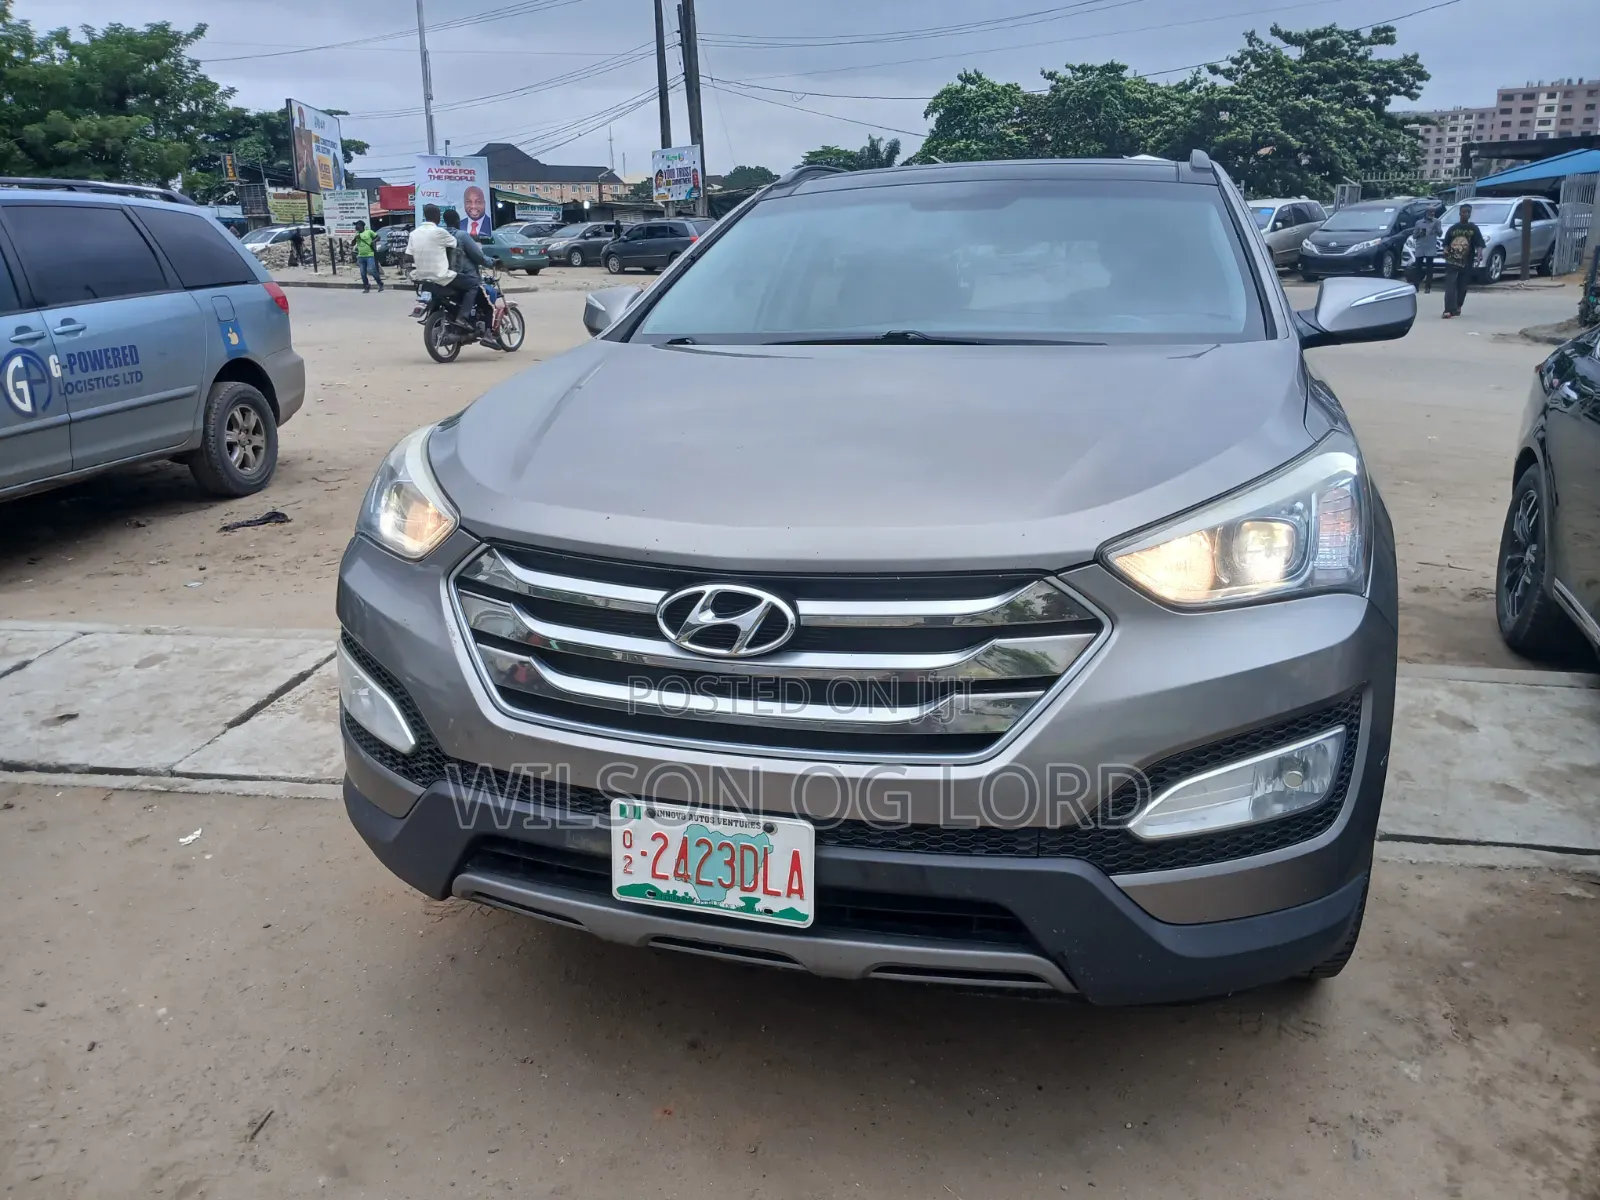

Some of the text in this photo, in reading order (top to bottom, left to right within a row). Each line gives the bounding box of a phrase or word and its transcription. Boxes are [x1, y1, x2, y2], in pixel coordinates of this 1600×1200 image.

[676, 166, 691, 178] TRUST
[49, 345, 140, 378] G-POWERED
[59, 371, 143, 396] LOGISTICS LTD
[688, 813, 715, 824] AUTOS
[717, 817, 762, 829] VENTURES
